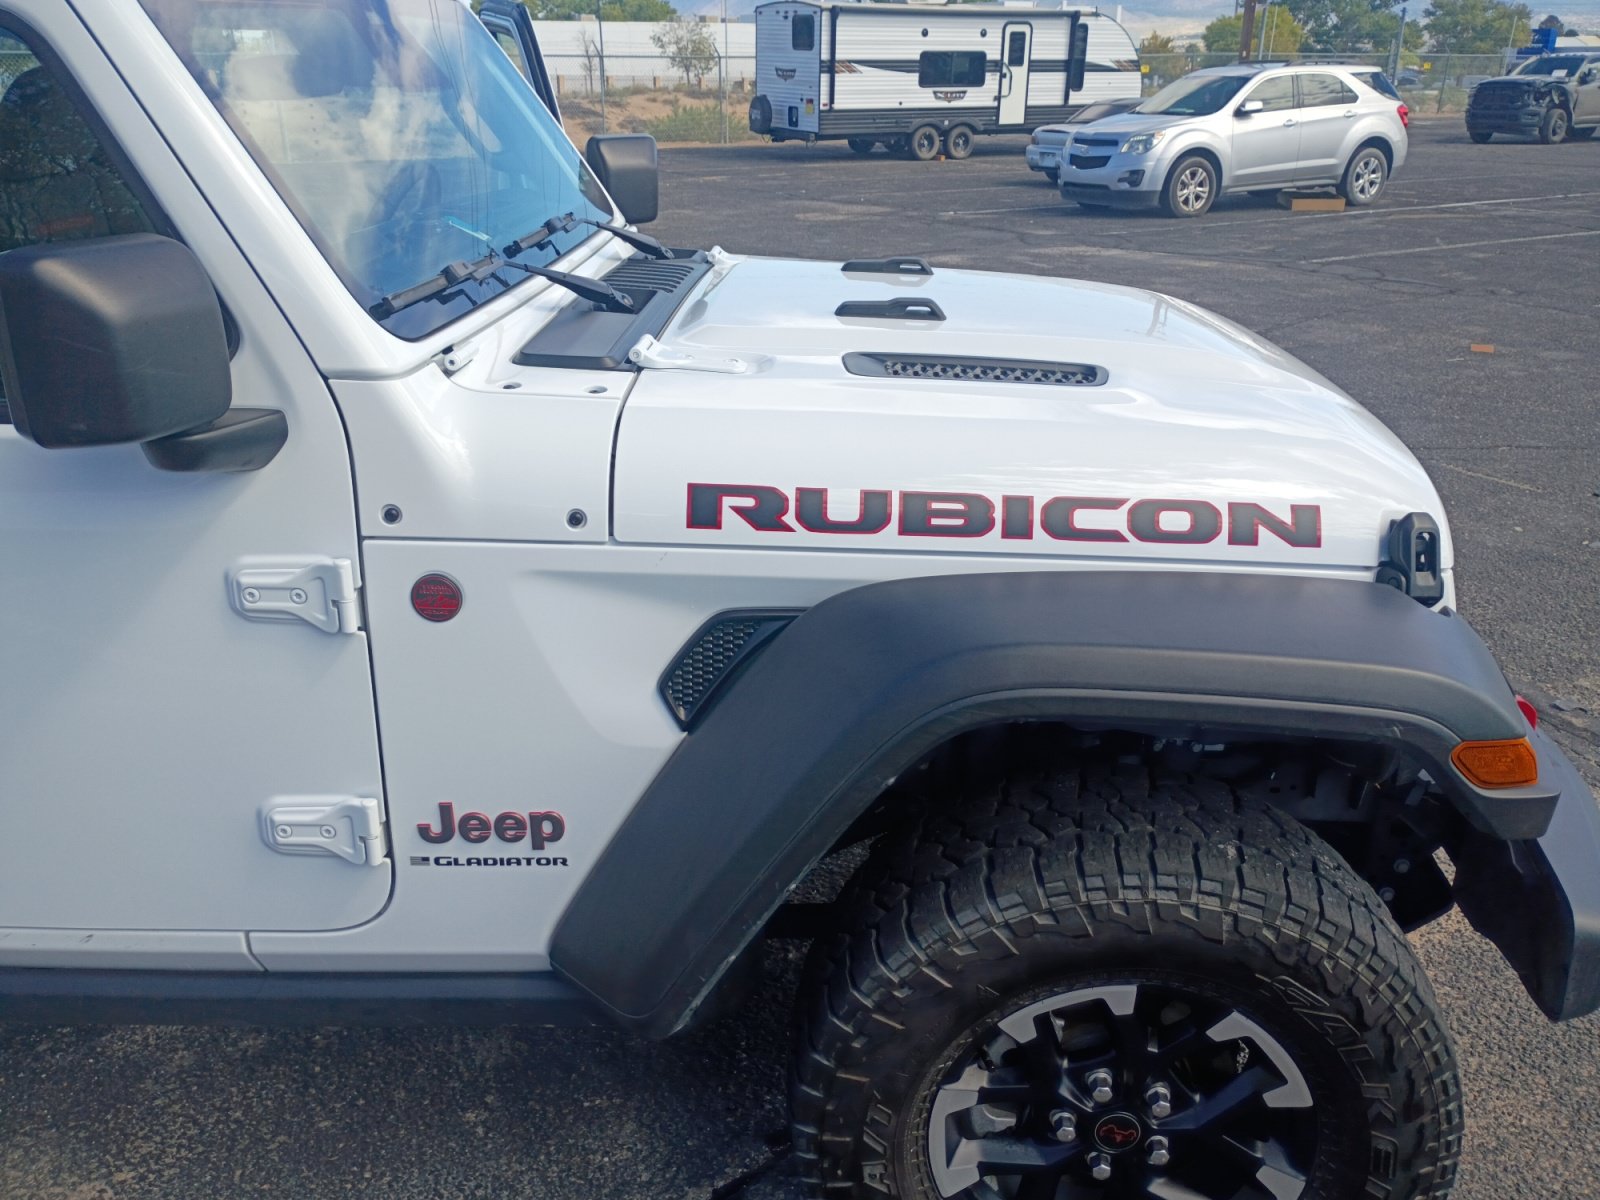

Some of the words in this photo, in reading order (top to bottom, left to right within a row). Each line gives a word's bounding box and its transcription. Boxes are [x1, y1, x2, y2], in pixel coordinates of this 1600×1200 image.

[686, 482, 1322, 548] RUBICON
[416, 801, 566, 850] Jeep
[434, 856, 569, 867] GLADIATOR
